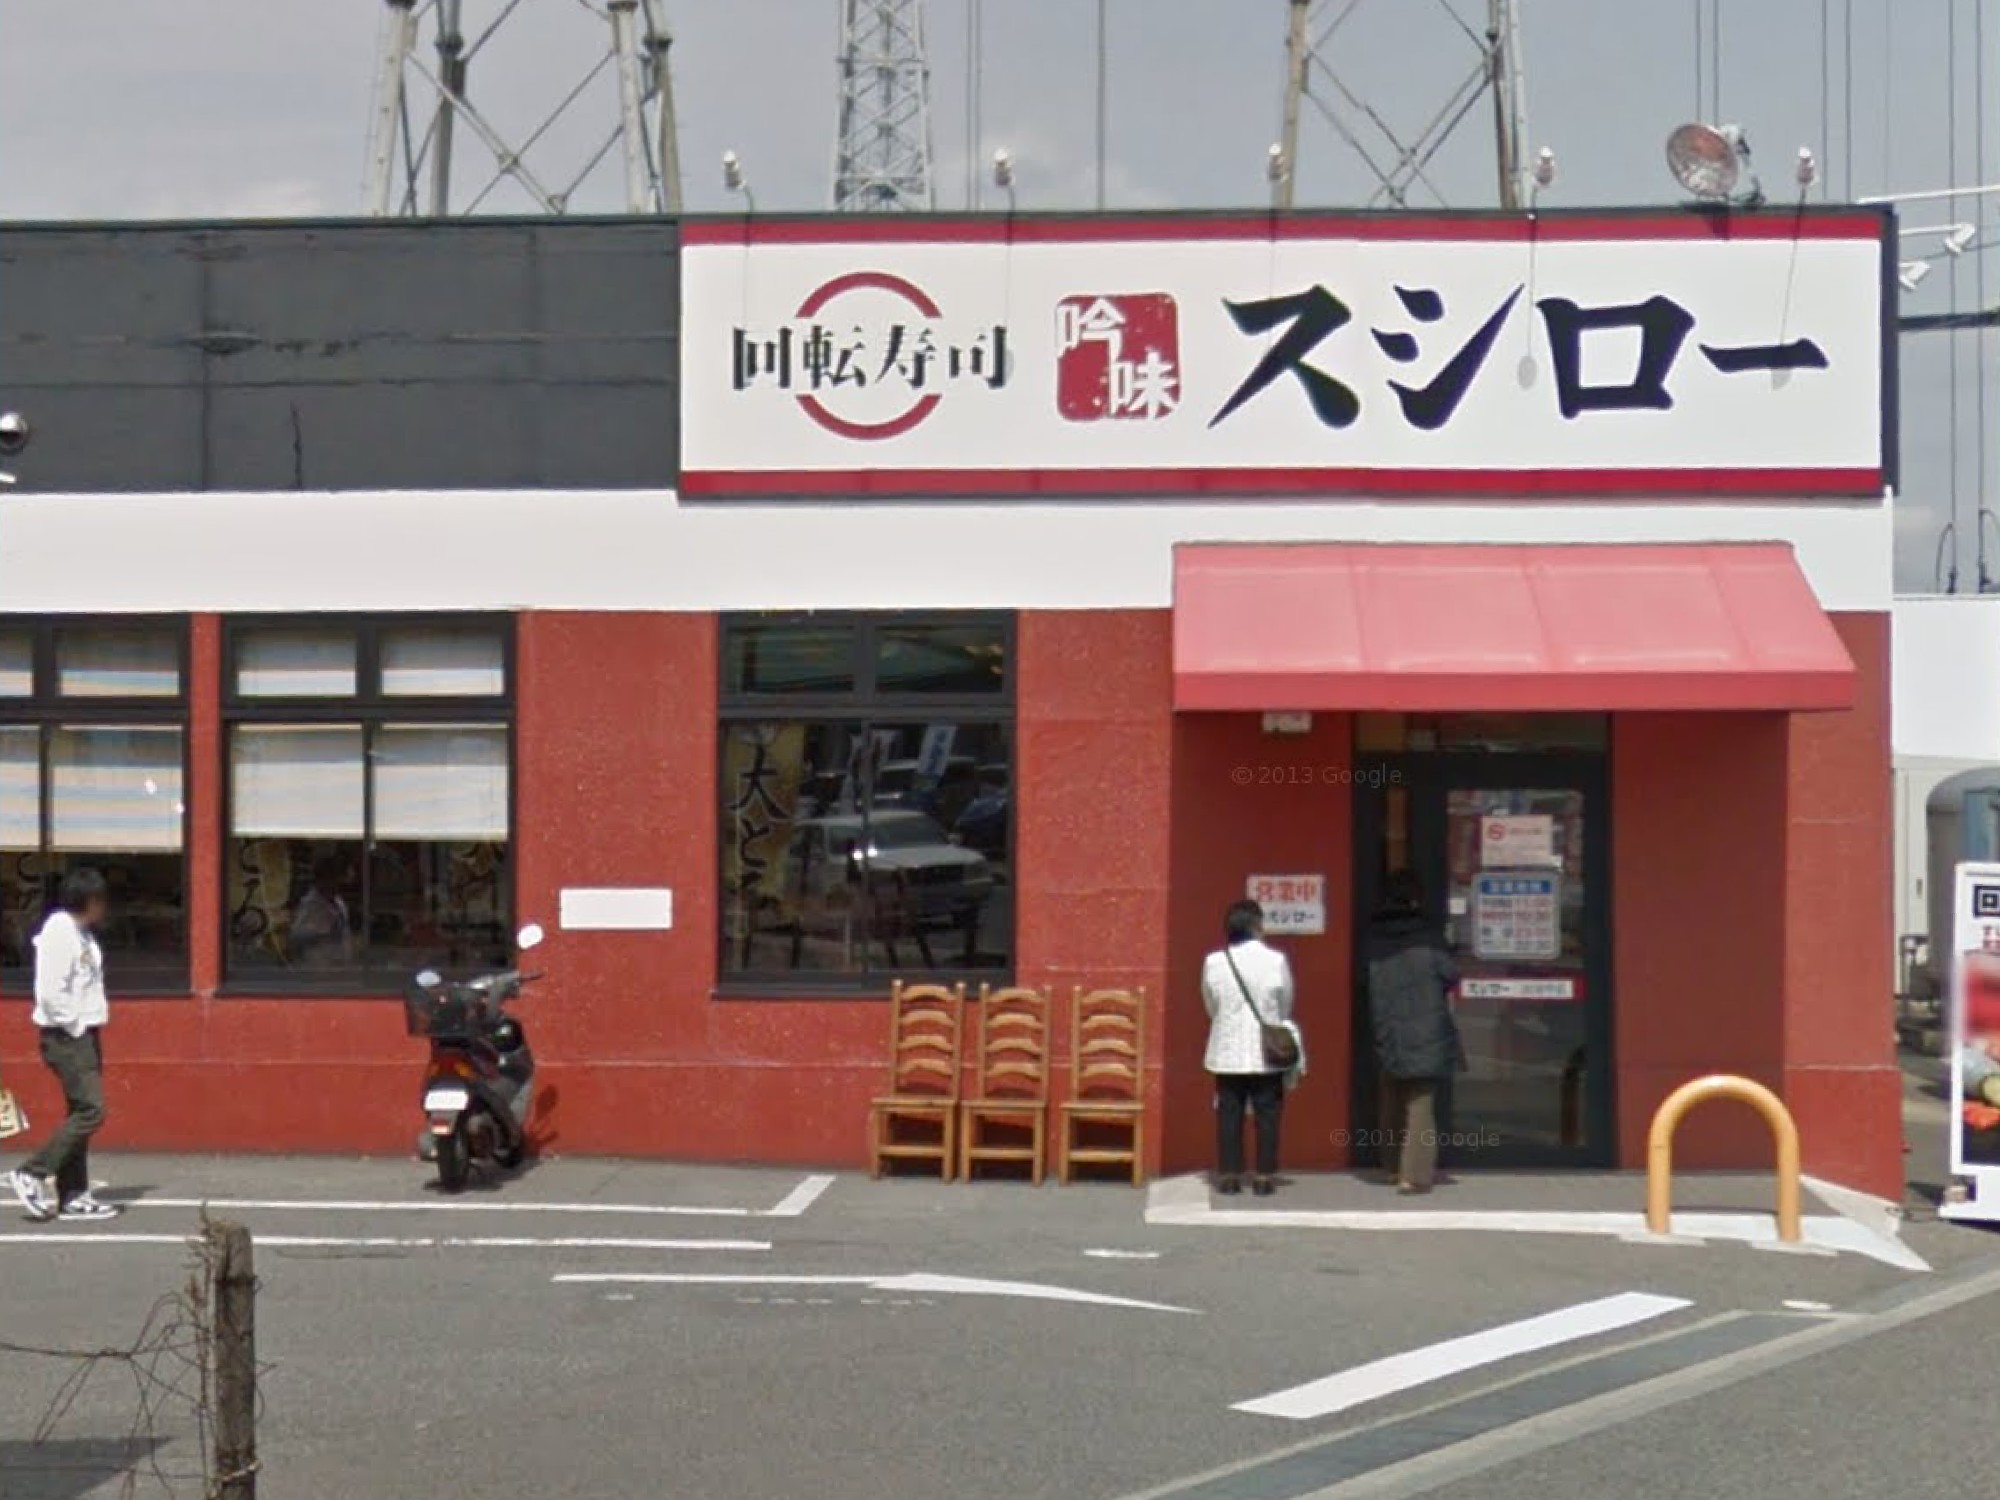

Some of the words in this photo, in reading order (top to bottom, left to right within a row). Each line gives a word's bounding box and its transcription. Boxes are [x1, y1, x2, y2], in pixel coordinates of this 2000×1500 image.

[733, 325, 1008, 391] 回転寿司
[1056, 297, 1180, 420] 吟味
[1209, 285, 1828, 429] スシロー
